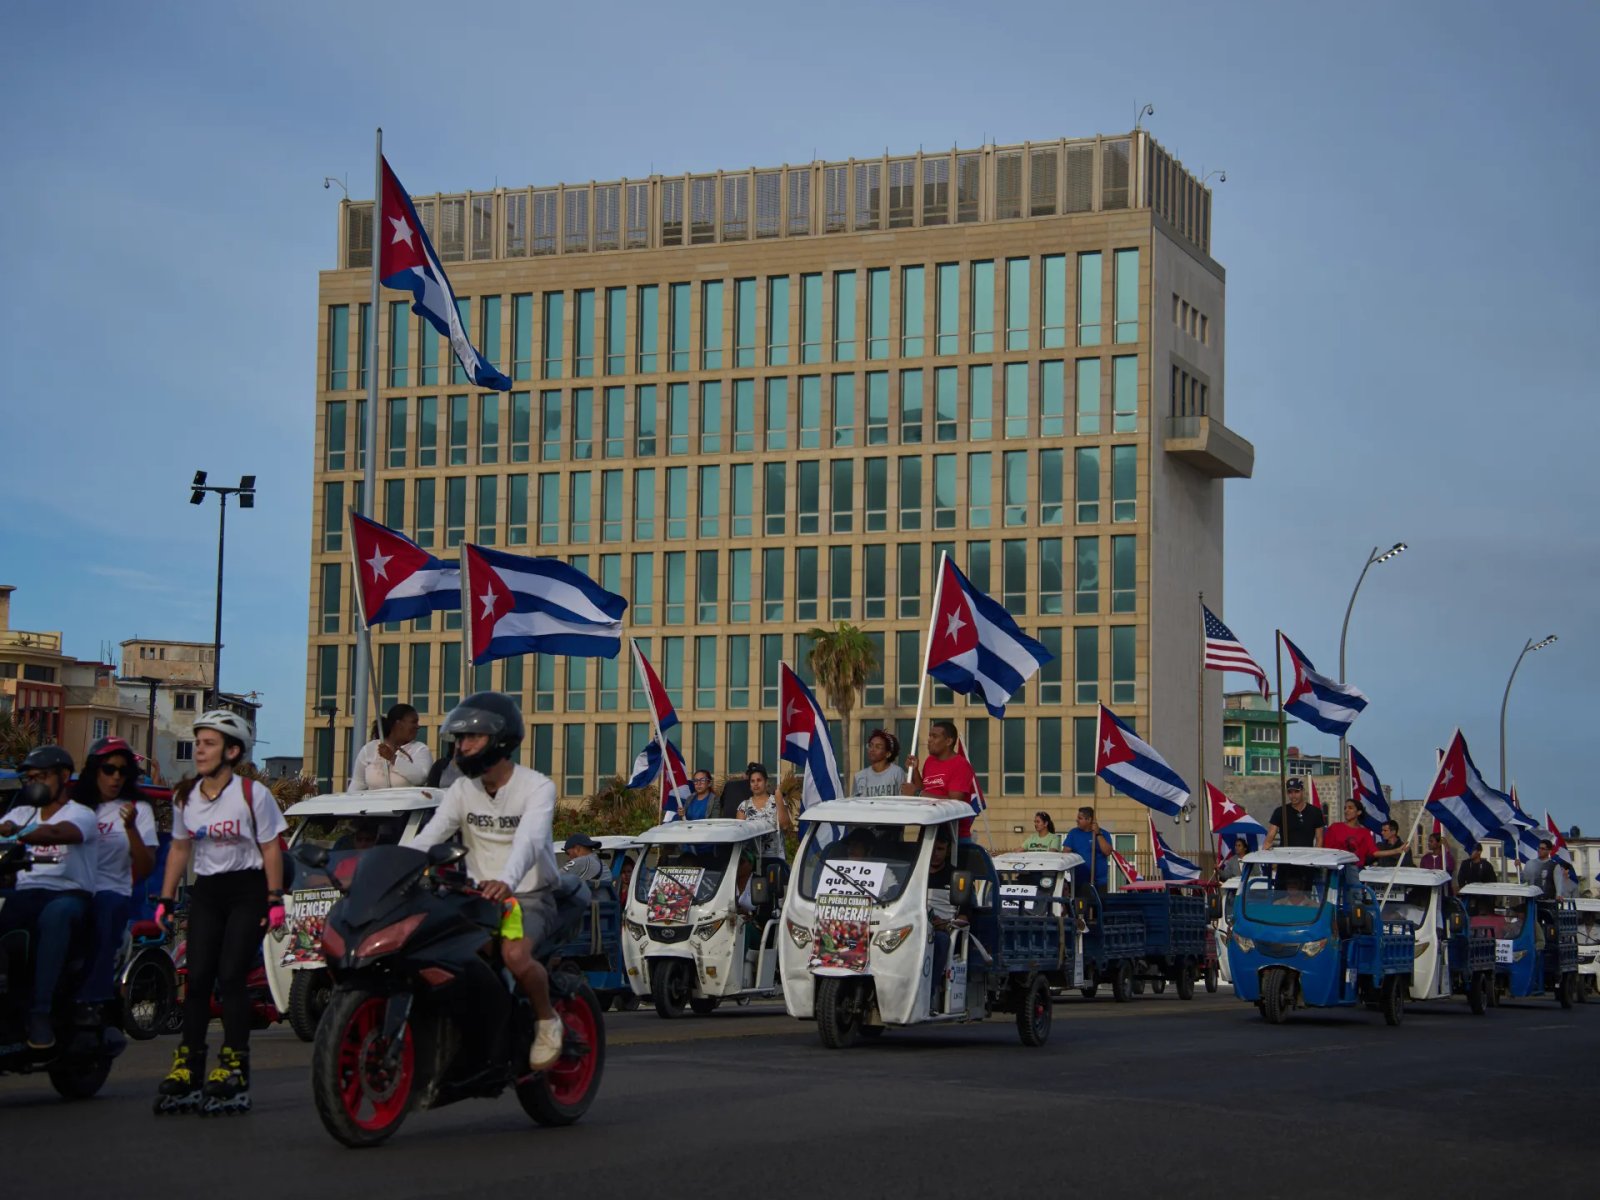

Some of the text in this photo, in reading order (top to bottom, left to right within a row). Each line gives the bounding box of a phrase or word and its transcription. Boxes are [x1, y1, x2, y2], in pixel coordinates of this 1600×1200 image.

[467, 812, 494, 827] GUESS
[209, 819, 240, 839] ISRI
[836, 866, 871, 876] Pa' lo
[853, 879, 875, 888] sea
[295, 901, 336, 917] VENCER
